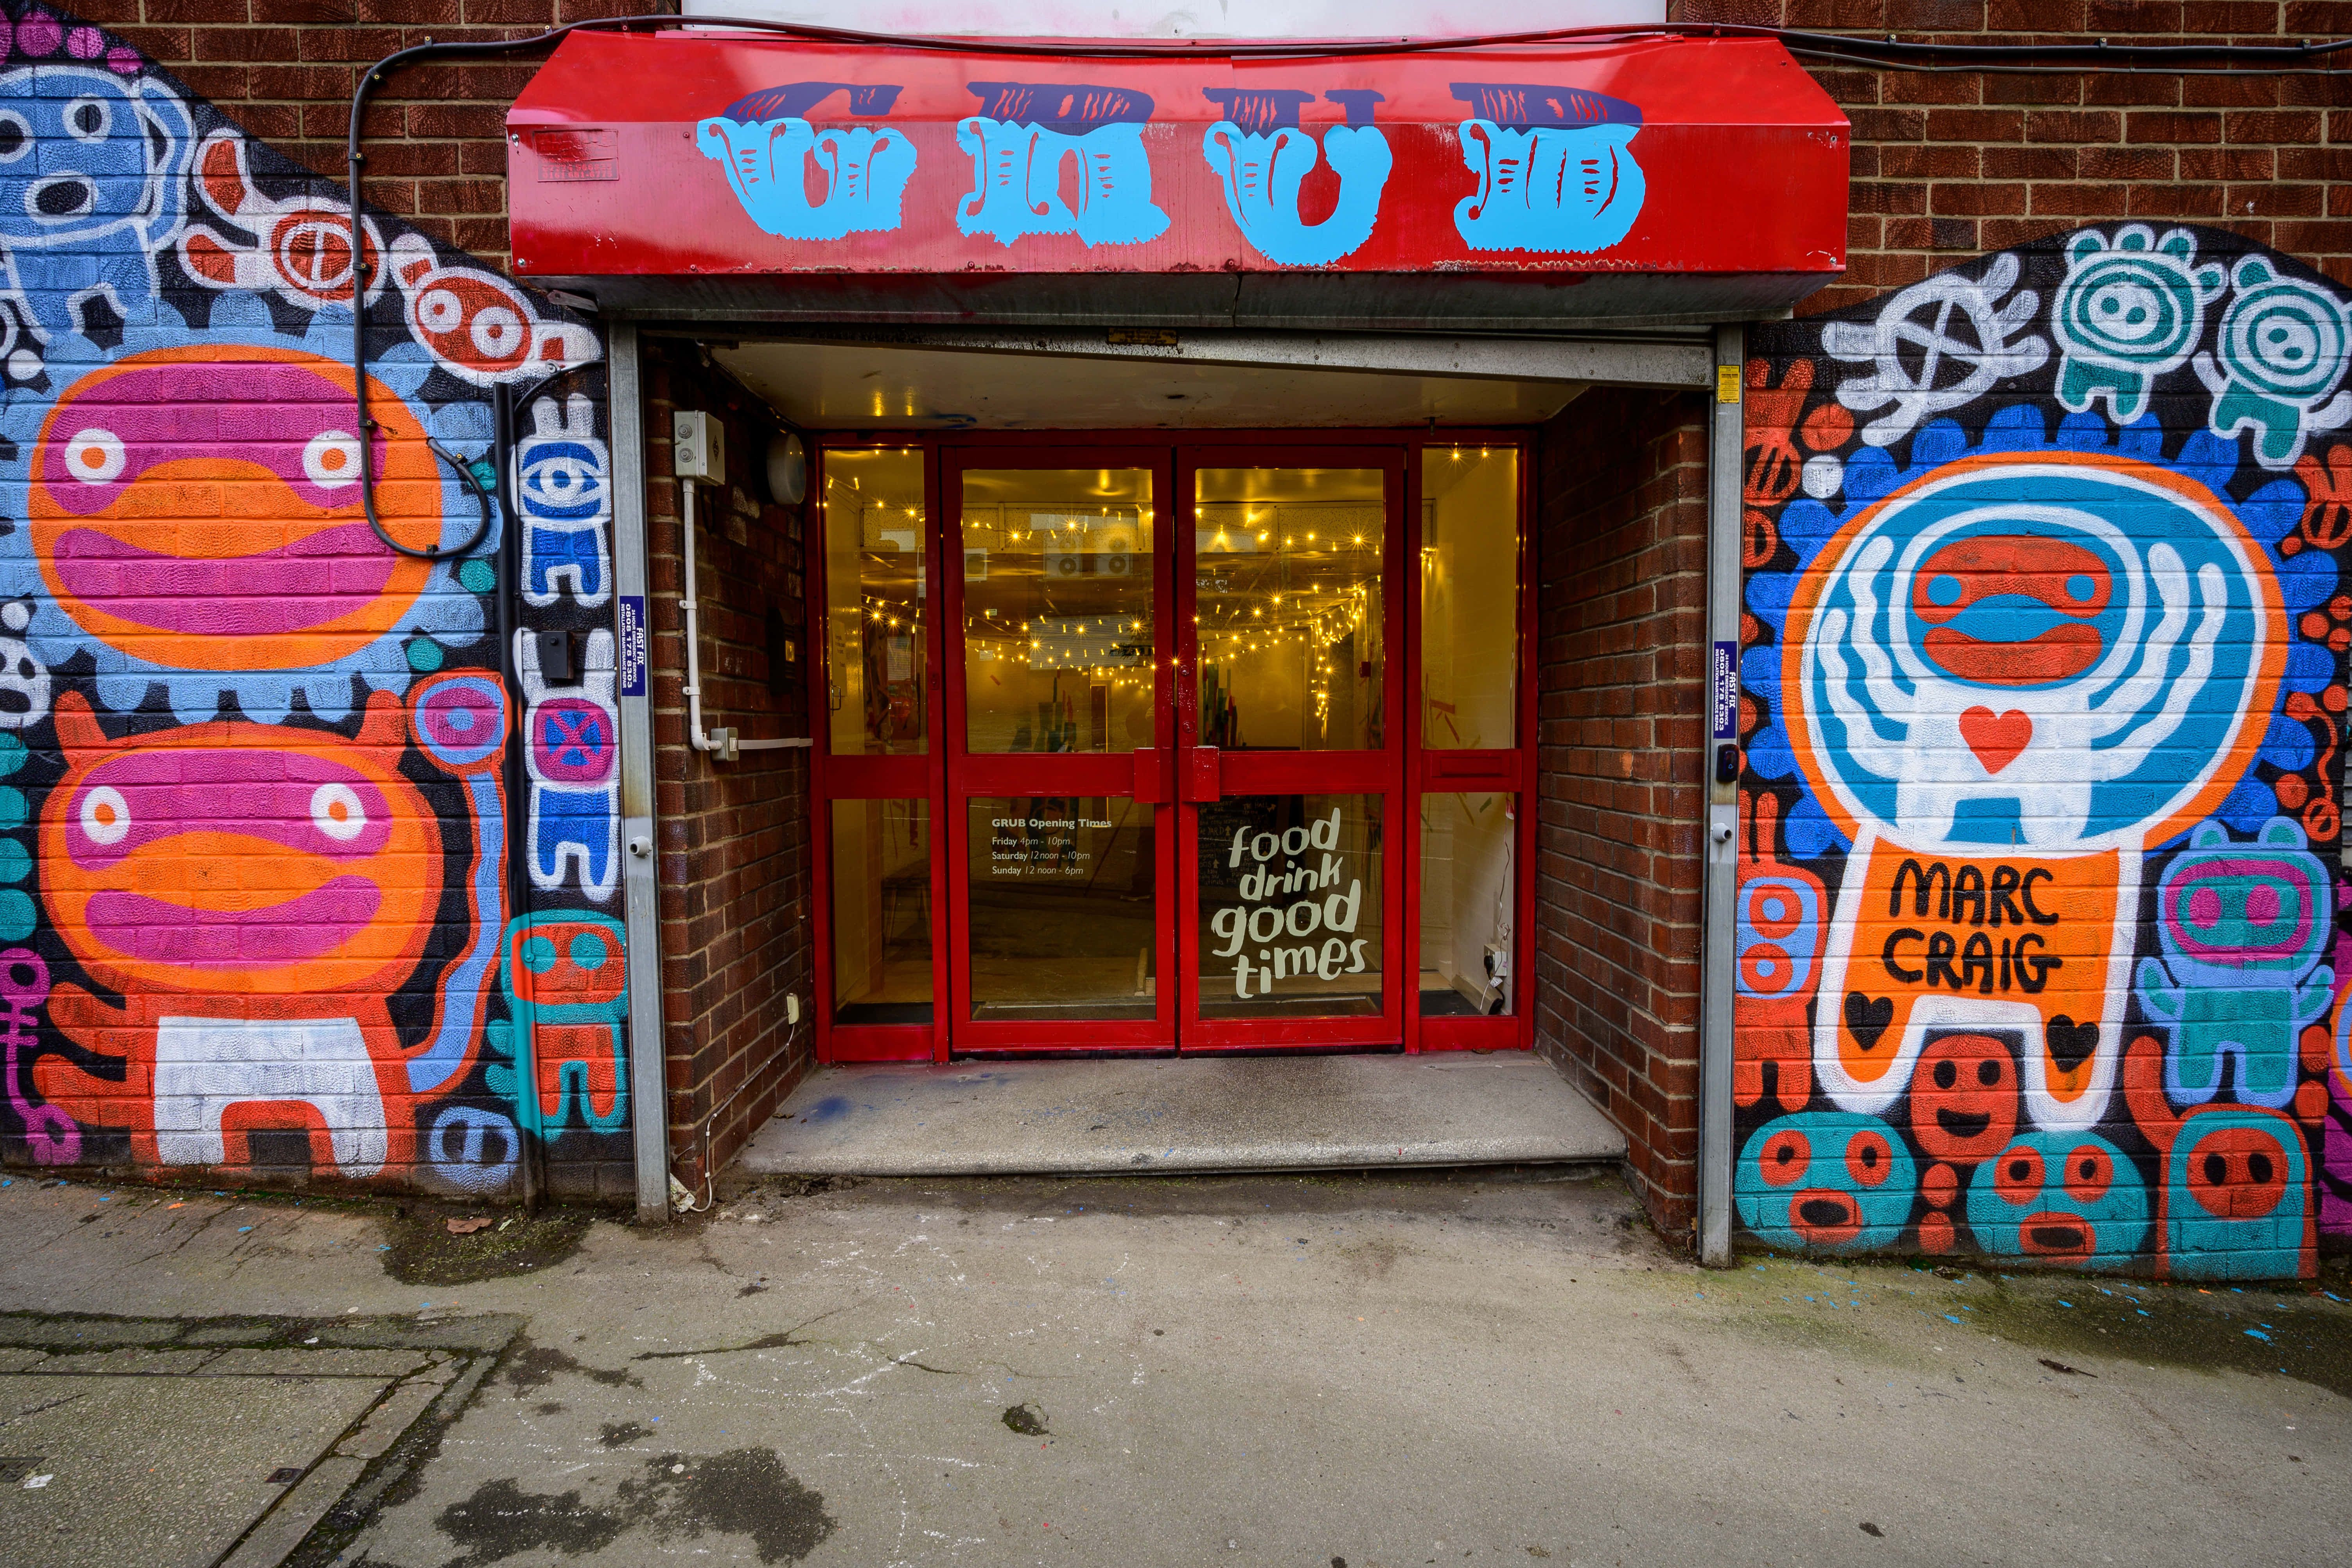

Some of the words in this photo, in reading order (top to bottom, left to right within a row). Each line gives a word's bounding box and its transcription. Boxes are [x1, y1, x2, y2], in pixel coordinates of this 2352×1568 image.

[696, 81, 1646, 267] GRUB
[992, 819, 1026, 827] GRUB
[1029, 819, 1075, 829] Opening
[1078, 819, 1111, 827] Times
[992, 837, 1017, 847] Friday
[1020, 837, 1038, 846] 4pm
[1048, 837, 1070, 846] 10pm
[1228, 807, 1341, 868] food
[992, 851, 1028, 861] Saturday
[1068, 851, 1090, 860] 10pm
[992, 866, 1021, 876] Sunday
[1025, 866, 1034, 874] 12
[1065, 866, 1083, 875] 6pm
[1239, 853, 1344, 901] drink
[1211, 879, 1361, 957] good
[1889, 858, 2059, 927] MARC
[1231, 938, 1369, 999] times
[1881, 927, 2063, 993] CRAIG
